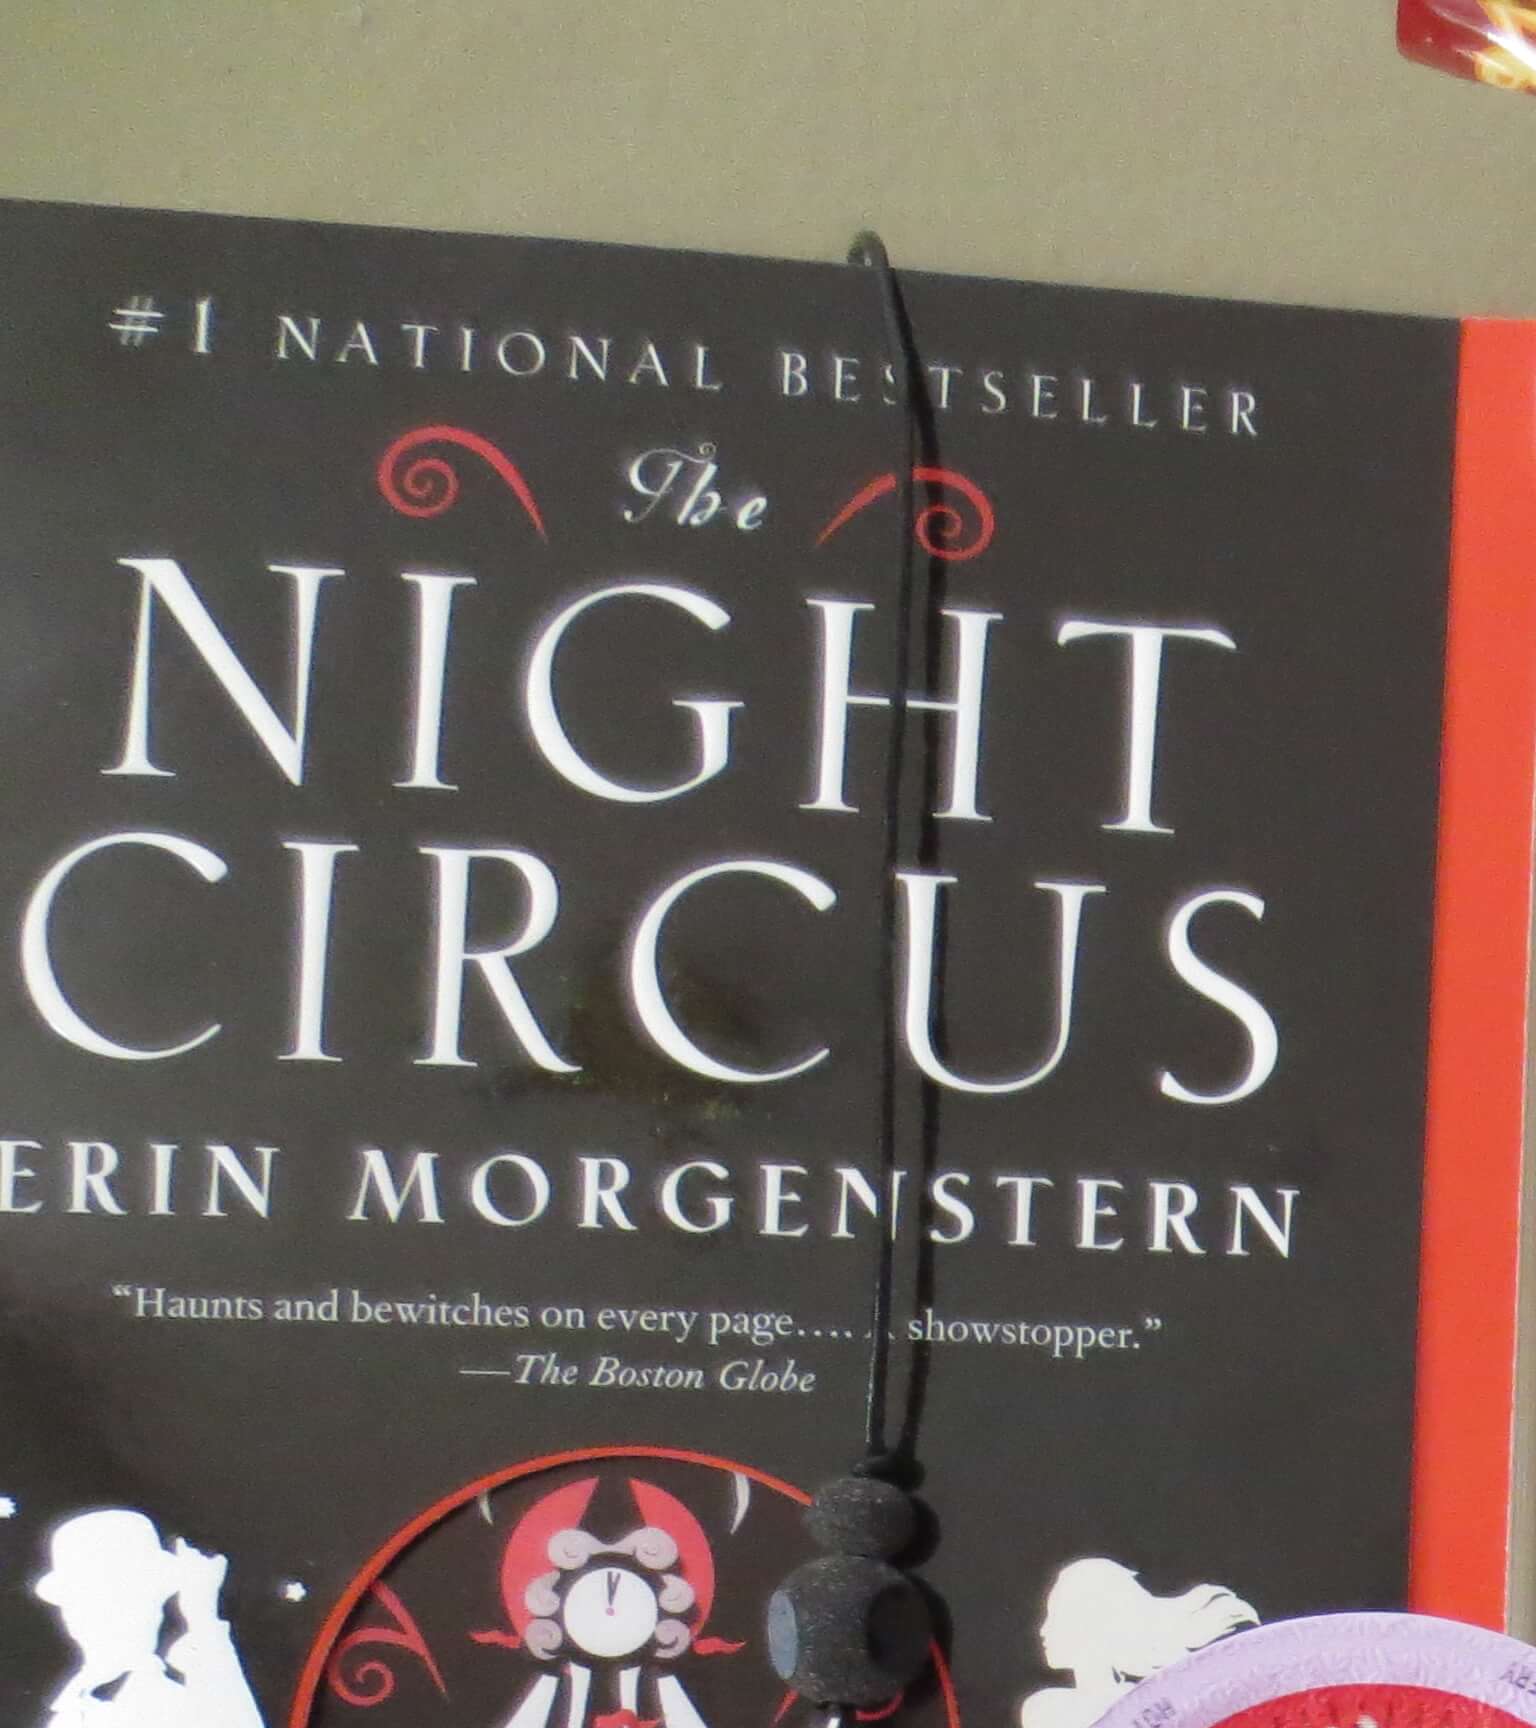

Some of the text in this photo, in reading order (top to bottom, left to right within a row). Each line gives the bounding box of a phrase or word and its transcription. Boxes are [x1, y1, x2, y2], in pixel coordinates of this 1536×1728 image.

[108, 294, 1260, 437] #1 NATIONAL BESTSELLER
[622, 441, 769, 531] The
[99, 556, 1238, 837] NIGHT
[19, 830, 1280, 1107] CIRCUS
[0, 1138, 1301, 1260] ERIN MORGENSTERN
[273, 1288, 340, 1324] and
[350, 1291, 530, 1331] bewitches
[540, 1304, 587, 1333] on
[597, 1307, 699, 1345] every
[588, 1356, 705, 1392] Boston
[718, 1360, 817, 1396] Globe
